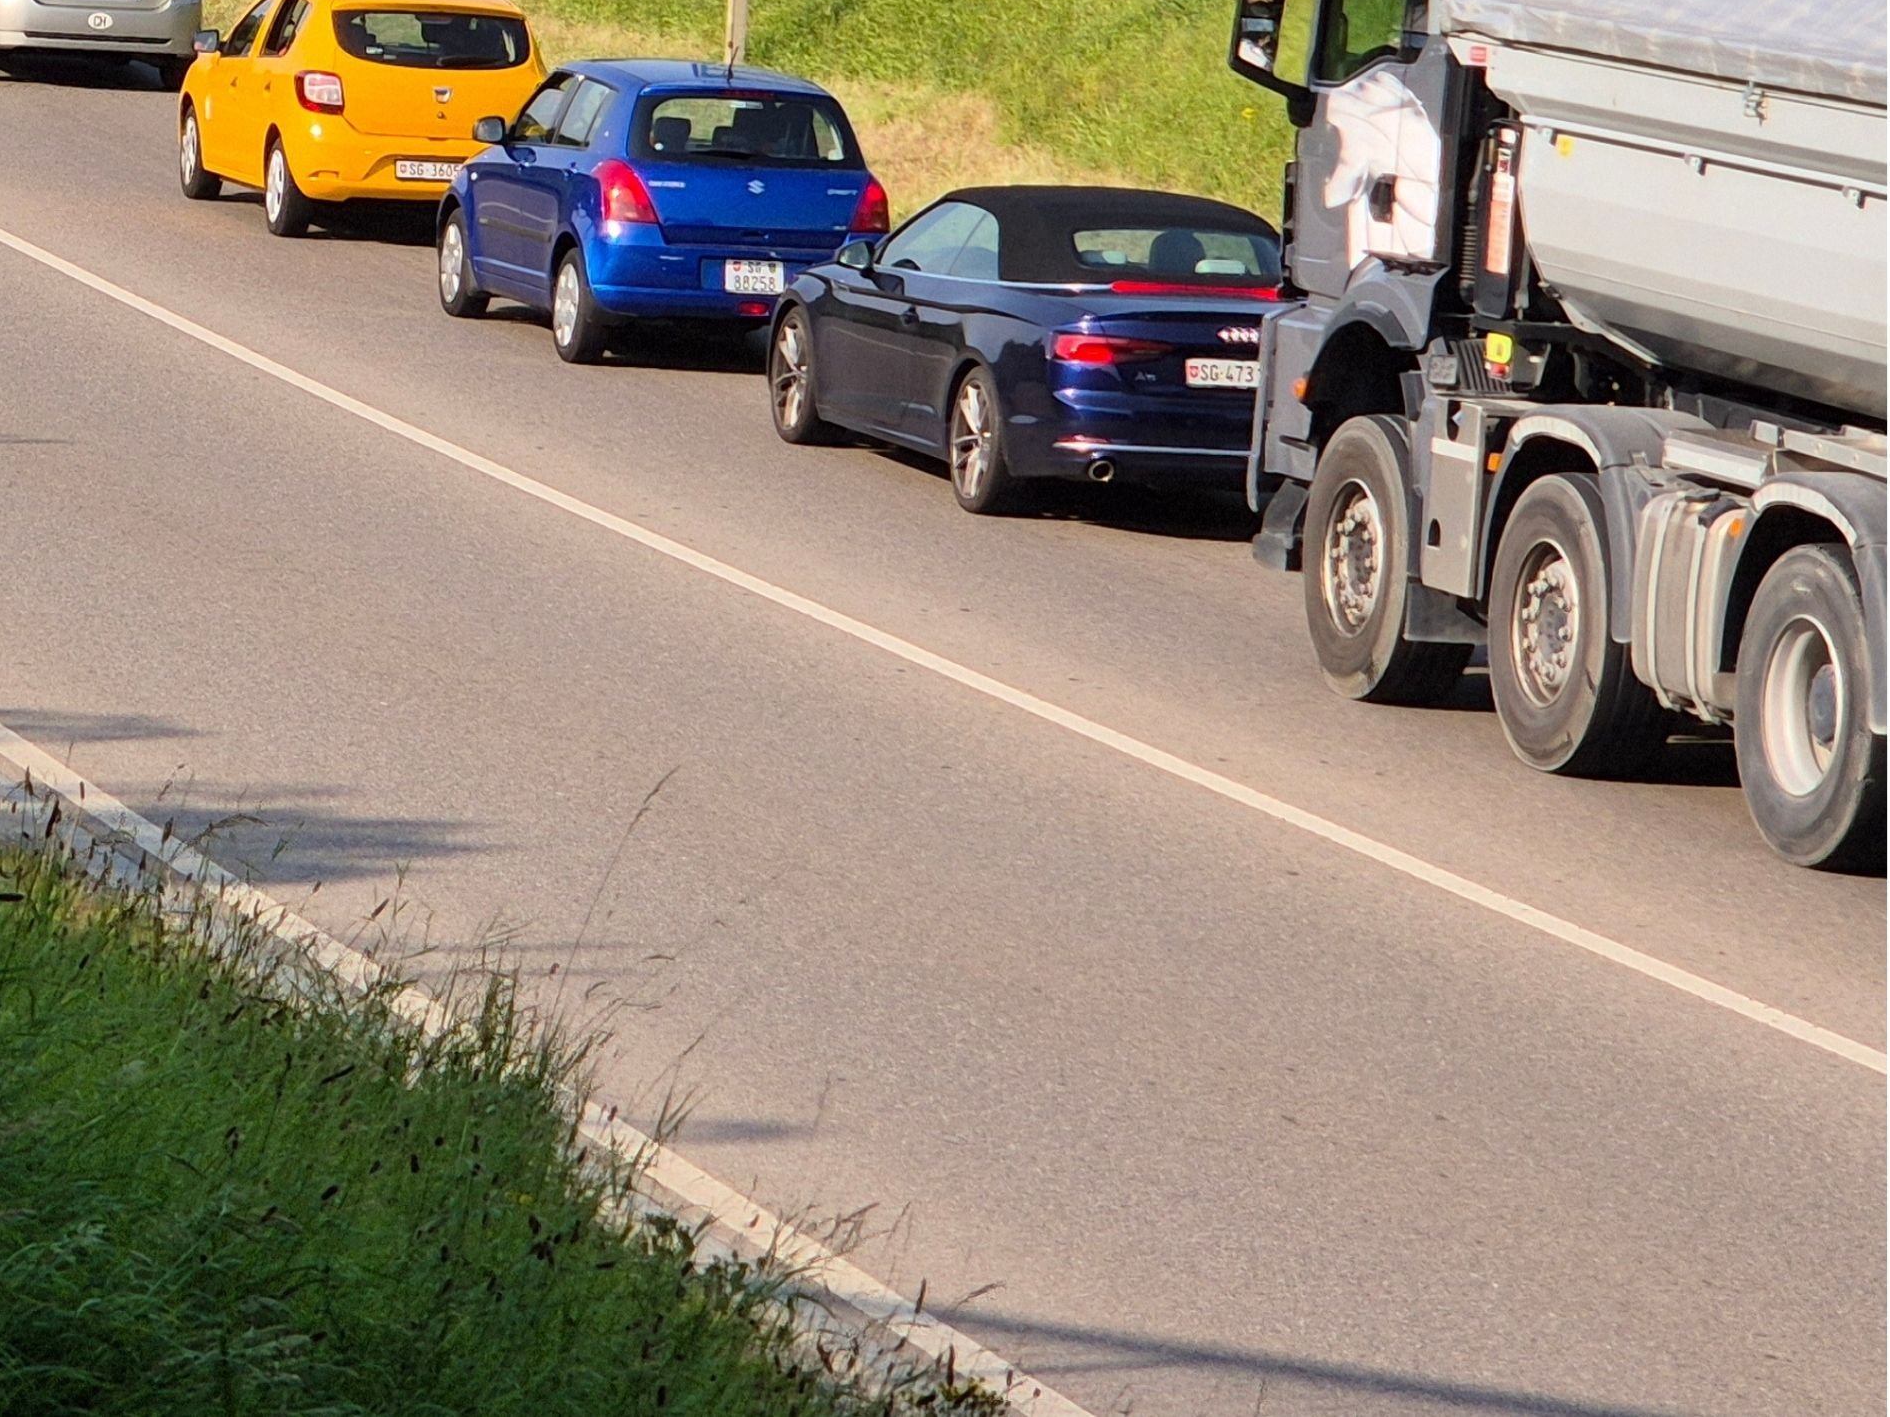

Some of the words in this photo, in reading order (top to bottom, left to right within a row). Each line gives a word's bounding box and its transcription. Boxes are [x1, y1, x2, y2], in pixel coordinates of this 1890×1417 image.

[93, 15, 107, 27] CH
[409, 162, 424, 176] SG
[1200, 364, 1220, 382] SG
[1225, 365, 1260, 383] 473
